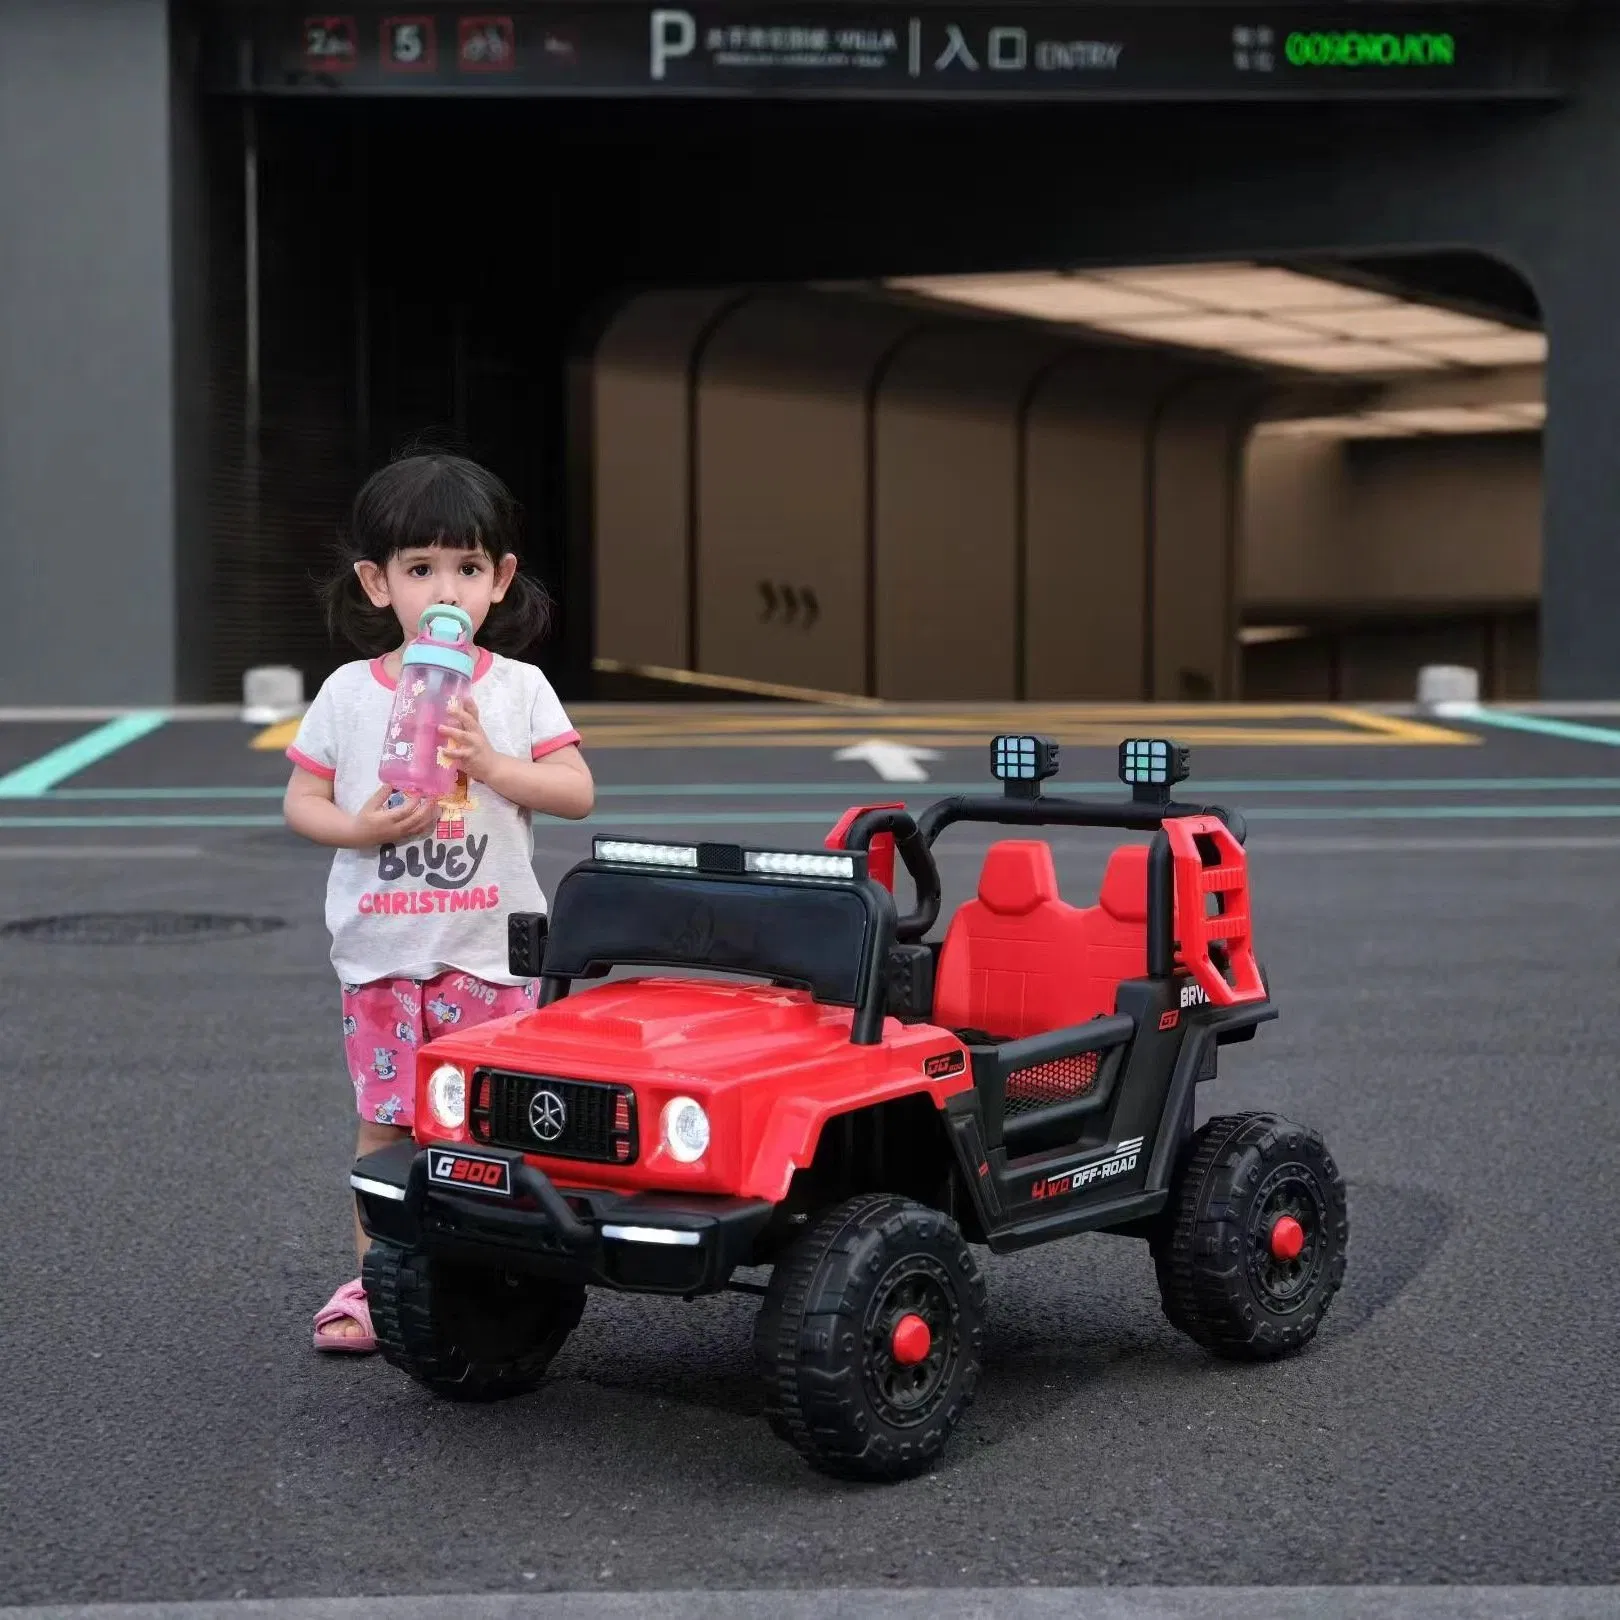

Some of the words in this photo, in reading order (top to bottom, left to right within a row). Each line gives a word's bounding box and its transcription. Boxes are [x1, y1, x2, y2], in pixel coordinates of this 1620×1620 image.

[394, 25, 423, 62] 5
[650, 8, 697, 80] P
[934, 24, 1029, 71] 入口
[378, 834, 489, 889] BLUEY
[358, 884, 500, 915] CHRISTMAS
[435, 1156, 502, 1186] G900
[1072, 1154, 1137, 1188] OFF-ROAD
